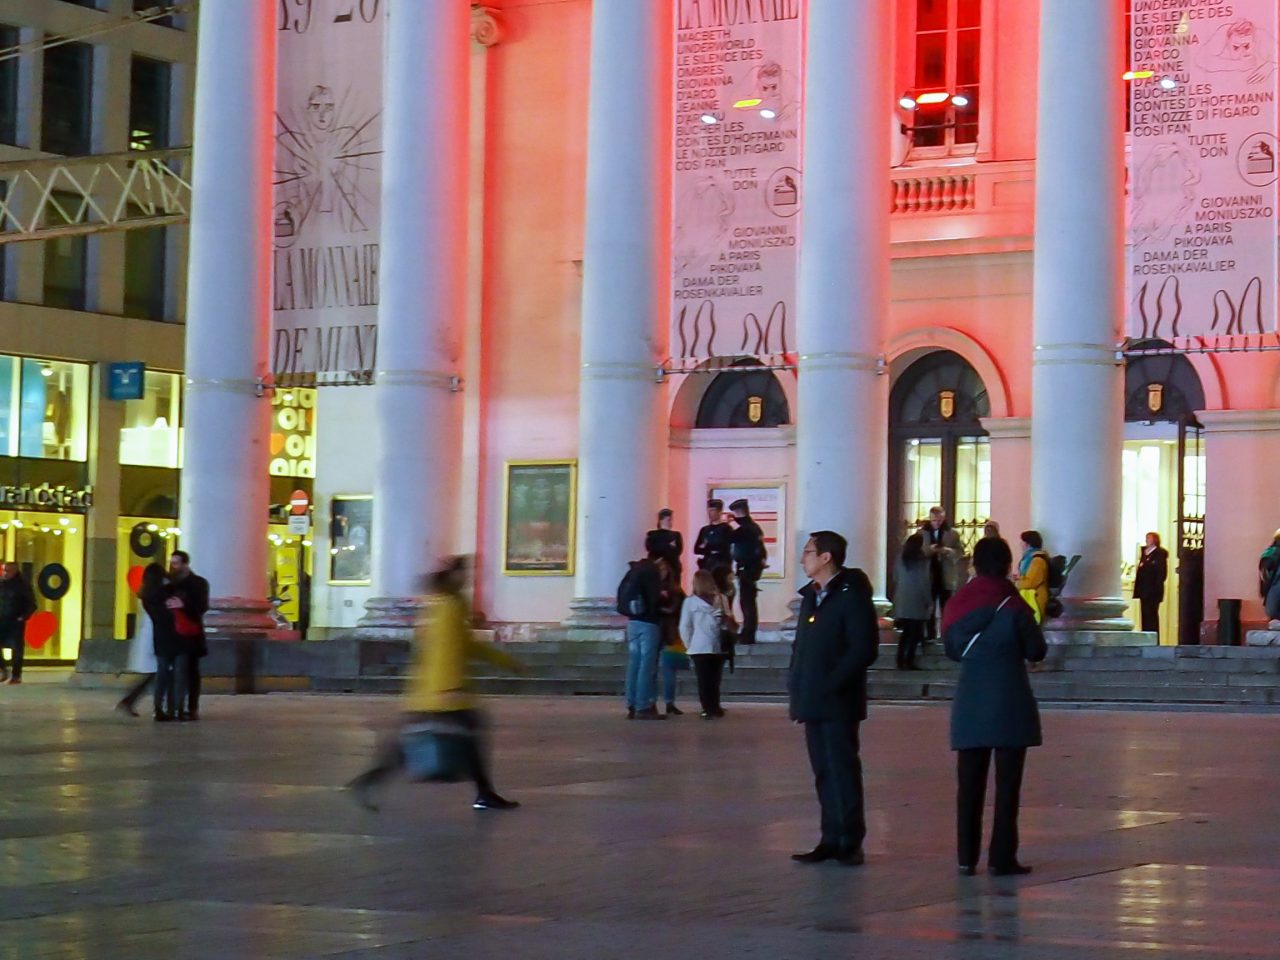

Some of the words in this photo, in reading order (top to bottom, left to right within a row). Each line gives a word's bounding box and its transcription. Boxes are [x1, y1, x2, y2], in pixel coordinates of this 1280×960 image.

[1134, 13, 1148, 24] LE
[1152, 8, 1206, 23] SILENCE
[1208, 6, 1233, 18] DES
[678, 29, 731, 42] MACBETH
[1134, 34, 1199, 50] GIOVANNA
[677, 56, 690, 66] LE
[741, 49, 763, 60] DES
[1134, 49, 1180, 62] D'ARCO
[1189, 84, 1212, 96] LES
[1134, 99, 1186, 112] CONTES
[1189, 92, 1274, 108] D'HOFFMANN
[1134, 113, 1148, 125] LE
[1152, 110, 1193, 123] NOZZE
[1196, 110, 1209, 120] DI
[1212, 106, 1260, 119] FIGARO
[724, 122, 744, 132] LES
[1134, 126, 1163, 137] COSI
[1167, 123, 1191, 135] FAN
[1188, 133, 1227, 146] TUTTE
[676, 150, 688, 160] LE
[692, 146, 728, 158] NOZZE
[730, 145, 741, 155] DI
[744, 142, 786, 154] FIGARO
[1200, 146, 1228, 158] DON
[705, 159, 726, 168] FAN
[723, 168, 757, 179] TUTTE
[733, 180, 758, 190] DON
[1201, 195, 1262, 209] GIOVANNI
[1195, 207, 1273, 221] MONIUSZKO
[734, 225, 788, 238] GIOVANNI
[1195, 222, 1232, 234] PARIS
[1174, 235, 1234, 248] PIKOVAYA
[729, 250, 760, 261] PARIS
[1143, 250, 1179, 262] DAMA
[1183, 249, 1208, 260] DER
[710, 262, 762, 274] PIKOVAYA
[1133, 261, 1236, 275] ROSENKAVALIER
[274, 249, 296, 311] LA
[300, 244, 379, 309] MONNAIE
[682, 276, 714, 288] DAMA
[717, 274, 739, 286] DER
[674, 285, 763, 300] ROSENKAVALIER
[274, 327, 308, 374] DE
